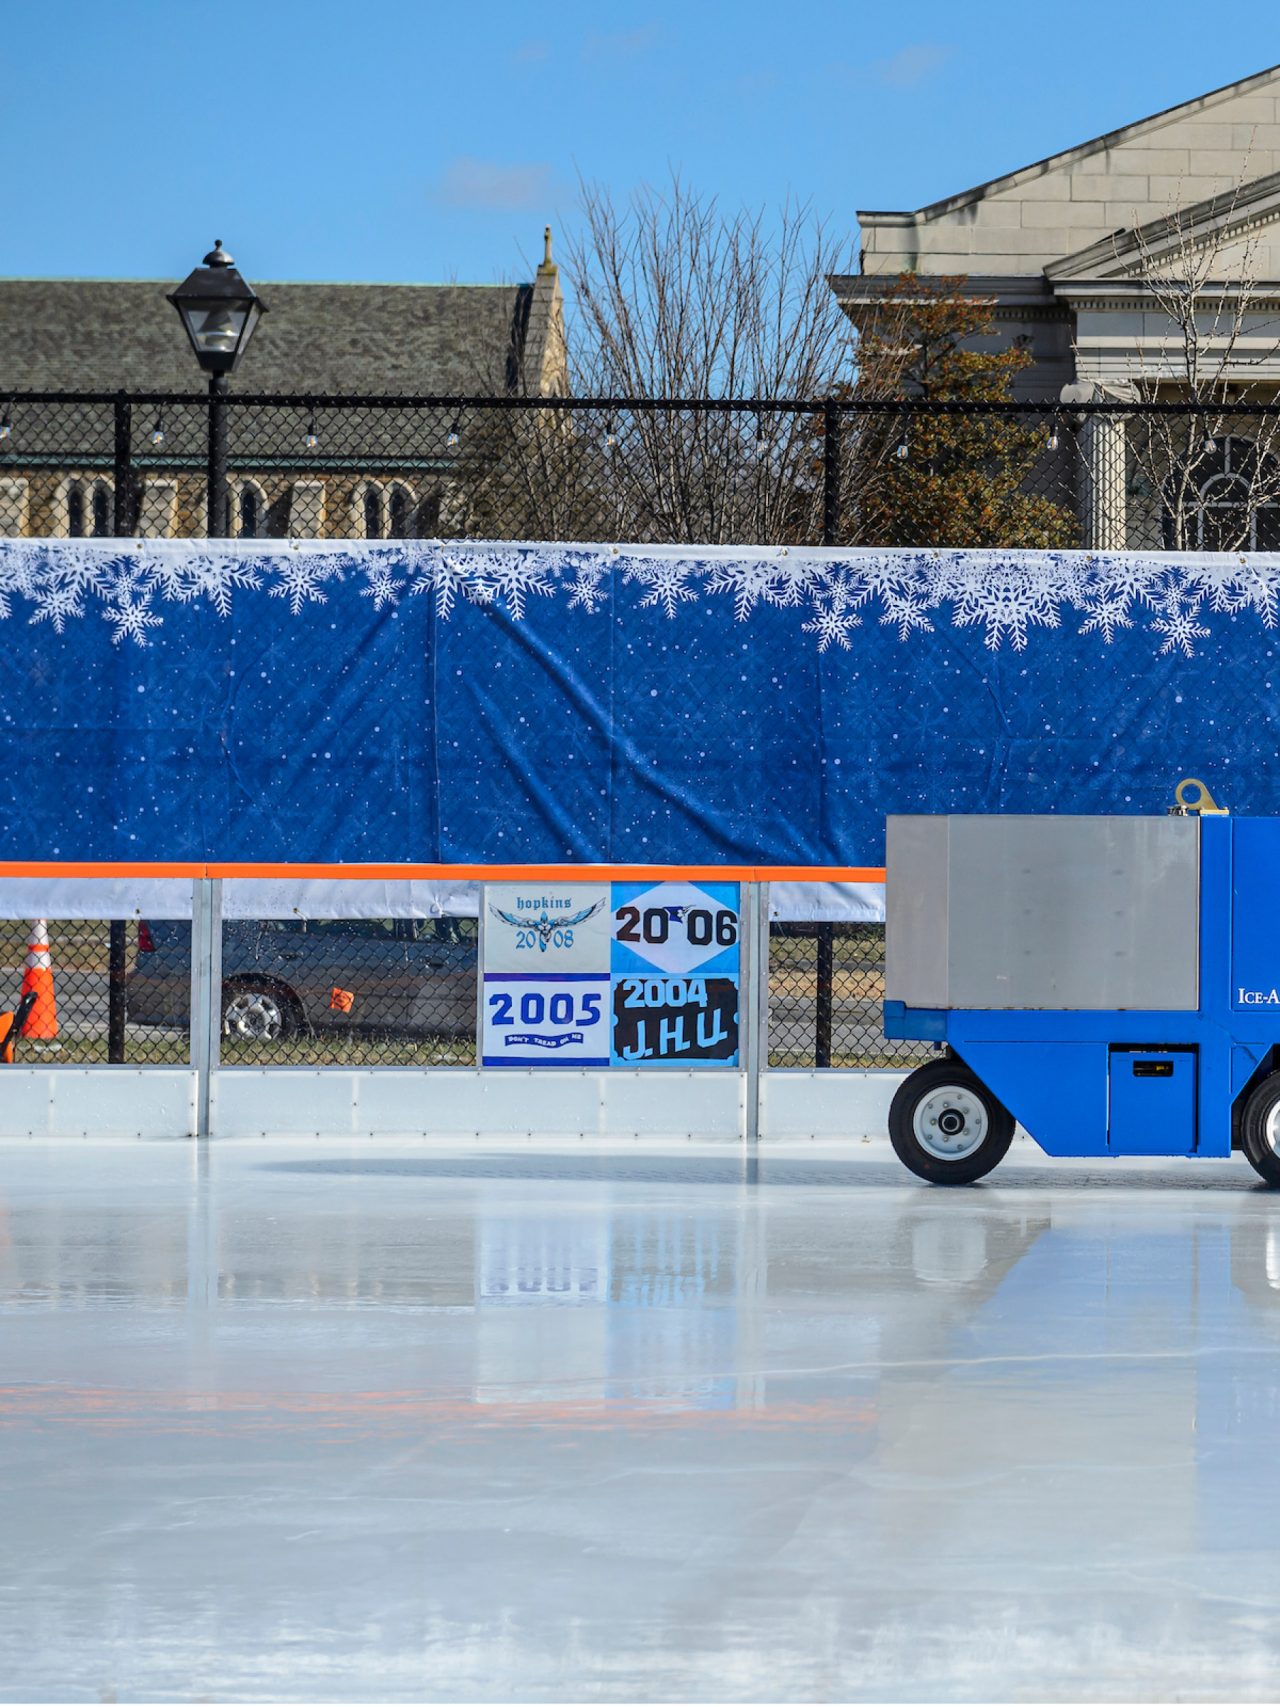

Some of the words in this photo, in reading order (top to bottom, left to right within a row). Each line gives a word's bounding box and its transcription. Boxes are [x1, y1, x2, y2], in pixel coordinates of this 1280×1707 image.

[516, 896, 572, 910] hopkins
[623, 978, 708, 1008] 2004
[489, 993, 601, 1026] 2005
[534, 1038, 557, 1047] TREAD
